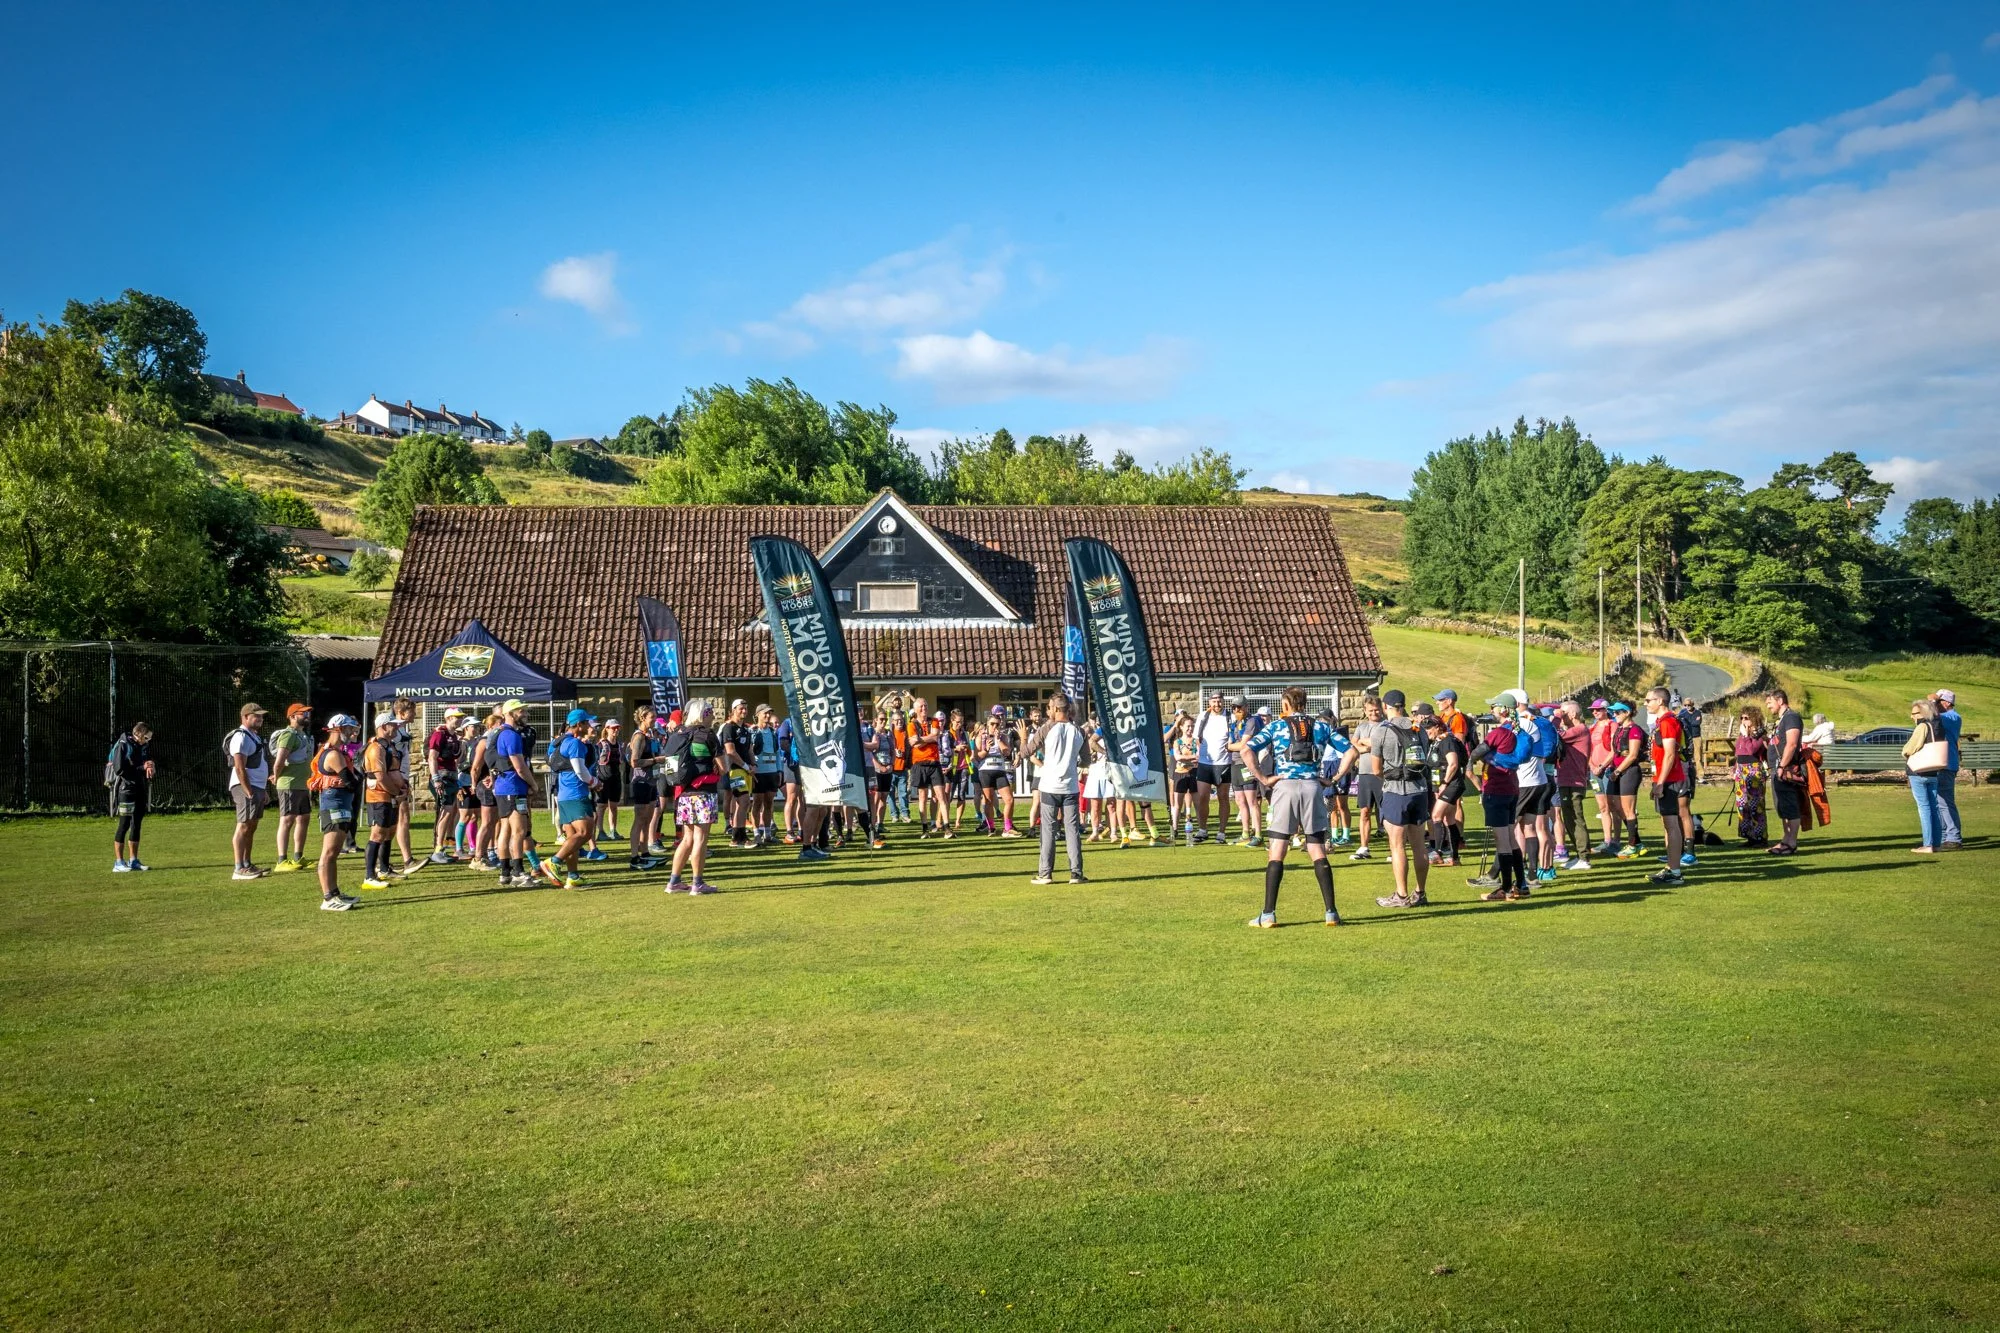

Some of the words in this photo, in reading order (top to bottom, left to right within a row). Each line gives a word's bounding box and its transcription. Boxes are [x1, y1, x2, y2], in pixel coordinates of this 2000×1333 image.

[782, 601, 814, 612] MOORS
[1091, 600, 1121, 612] MOORS
[395, 687, 432, 697] MIND
[434, 687, 472, 696] OVER
[475, 687, 525, 696] MOORS
[781, 618, 792, 646] NORTH
[787, 646, 802, 689] YORKSHIRE
[796, 690, 806, 712] TRAIL
[801, 713, 812, 737] RACES
[788, 615, 833, 736] MOORS
[807, 612, 833, 667] MIND
[824, 673, 847, 730] OVER
[1088, 618, 1097, 645] NORTH
[1093, 647, 1107, 688] YORKSHIRE
[1101, 689, 1111, 710] TRAIL
[1107, 711, 1117, 735] RACES
[1096, 616, 1137, 734] MOORS
[1114, 613, 1136, 667] MIND
[1126, 672, 1147, 729] OVER
